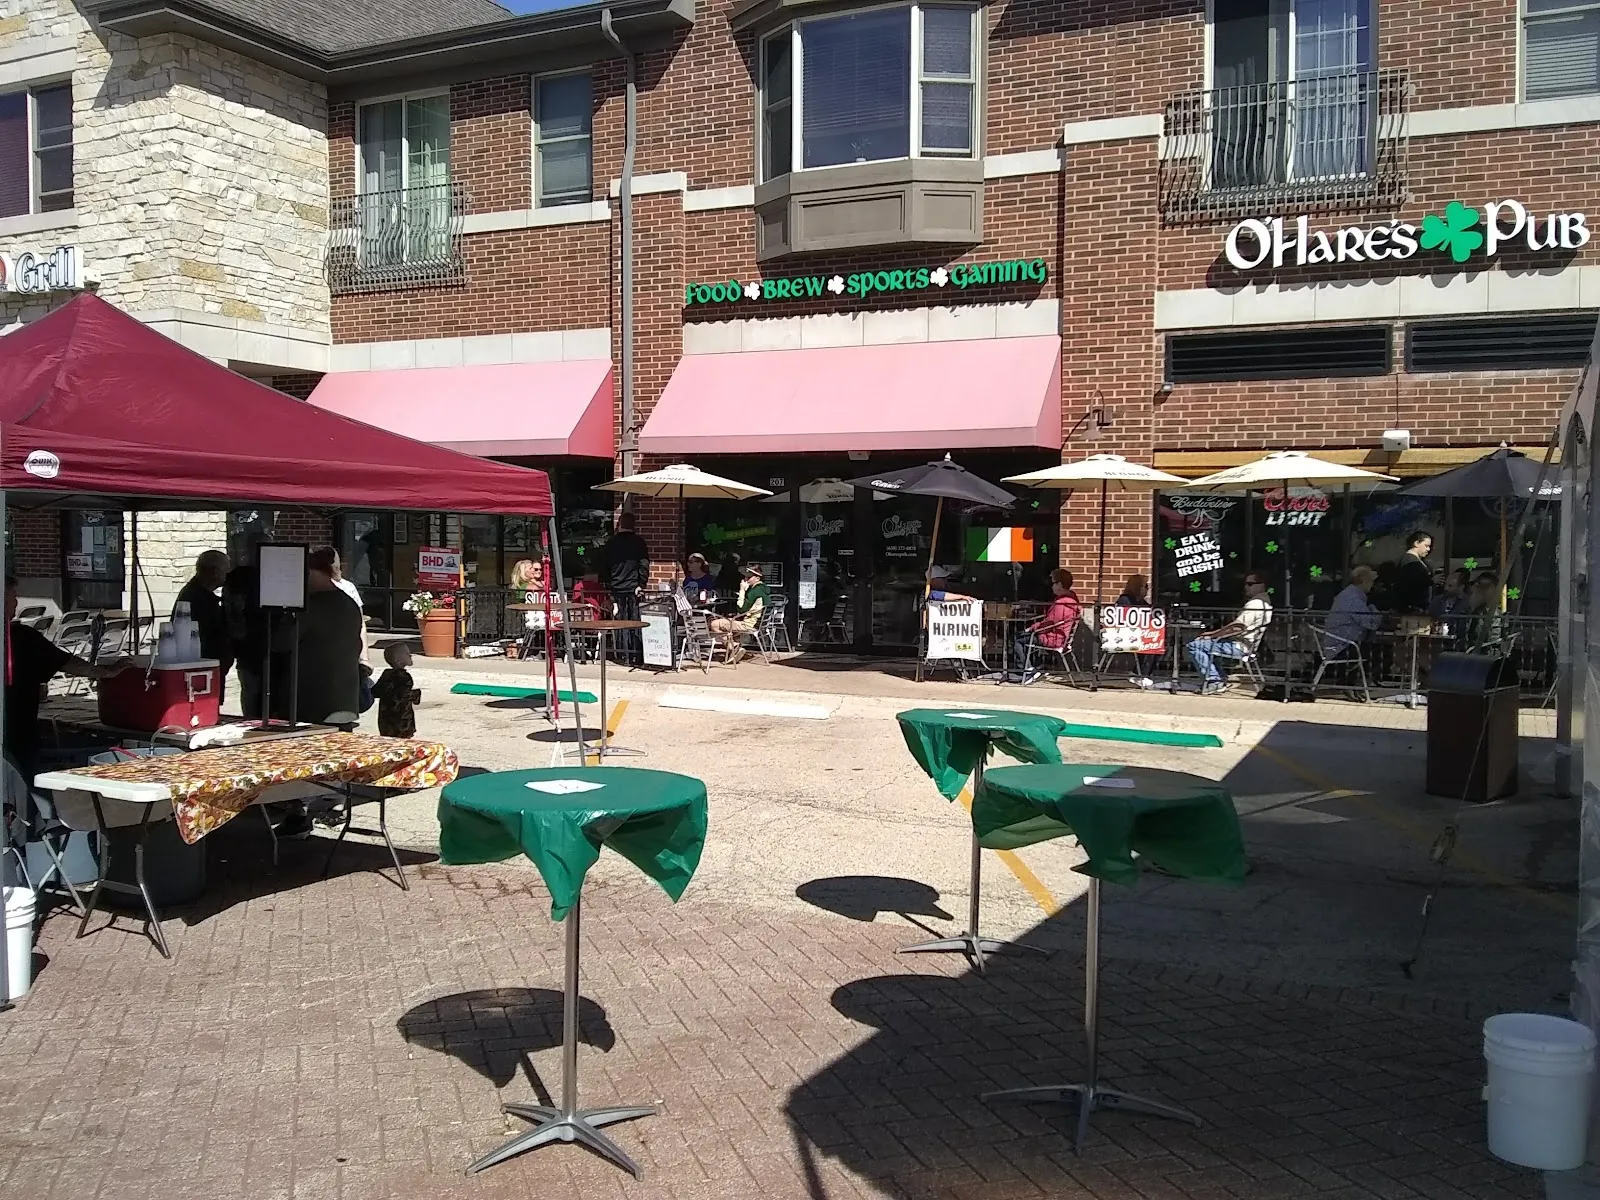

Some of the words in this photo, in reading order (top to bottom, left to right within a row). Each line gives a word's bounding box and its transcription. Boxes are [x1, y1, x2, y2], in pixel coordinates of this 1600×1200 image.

[1225, 216, 1419, 270] O'Hare's
[1483, 199, 1592, 257] Pub
[15, 246, 76, 294] Grill
[763, 276, 827, 301] BREW
[770, 478, 784, 486] 207
[1265, 511, 1326, 526] LIGHT
[1180, 532, 1210, 547] EAT,
[1174, 540, 1221, 558] DRINK,
[422, 555, 444, 567] BHD
[1175, 554, 1203, 568] and
[1202, 552, 1221, 562] be
[1177, 558, 1225, 578] IRISH!
[939, 603, 972, 617] NOW
[1104, 606, 1166, 629] SLOTS
[933, 622, 980, 637] HIRING
